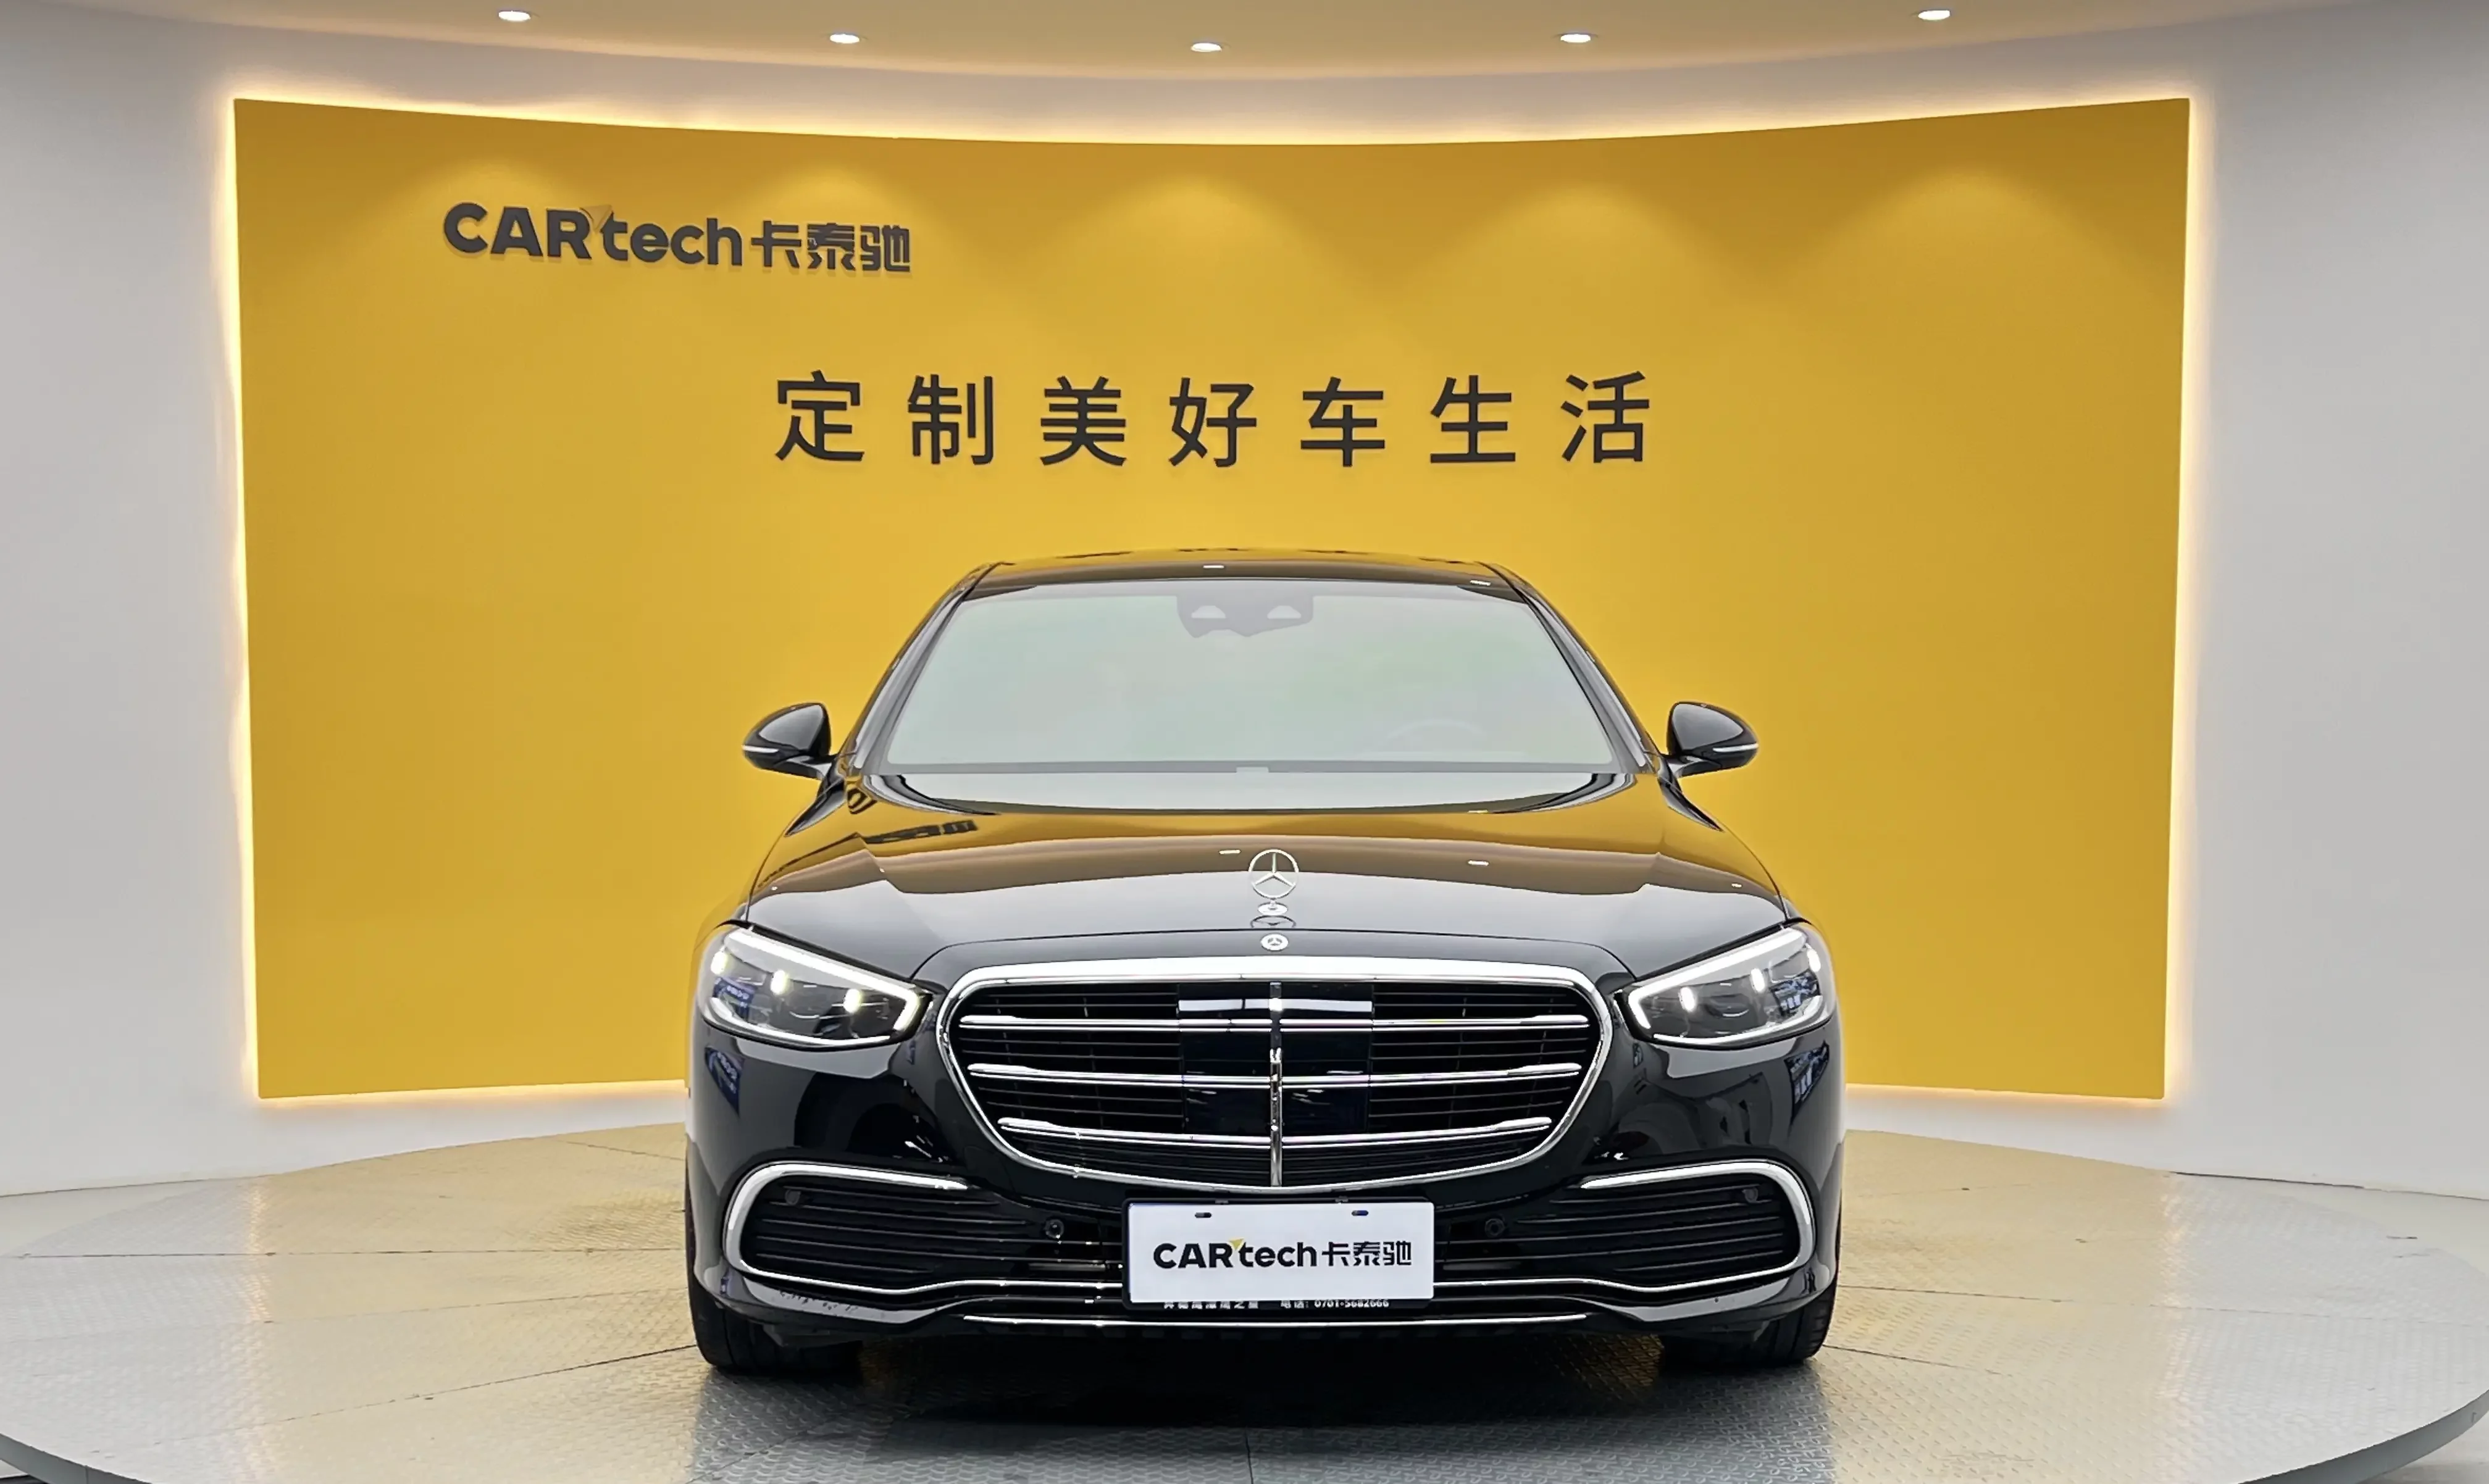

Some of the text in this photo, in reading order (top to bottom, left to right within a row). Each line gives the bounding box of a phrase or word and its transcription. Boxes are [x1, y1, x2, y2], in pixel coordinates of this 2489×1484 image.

[443, 202, 910, 272] CARtech 卡泰驰
[775, 370, 1650, 468] 定制美好车生活
[1153, 1241, 1412, 1269] CARtech 卡泰驰
